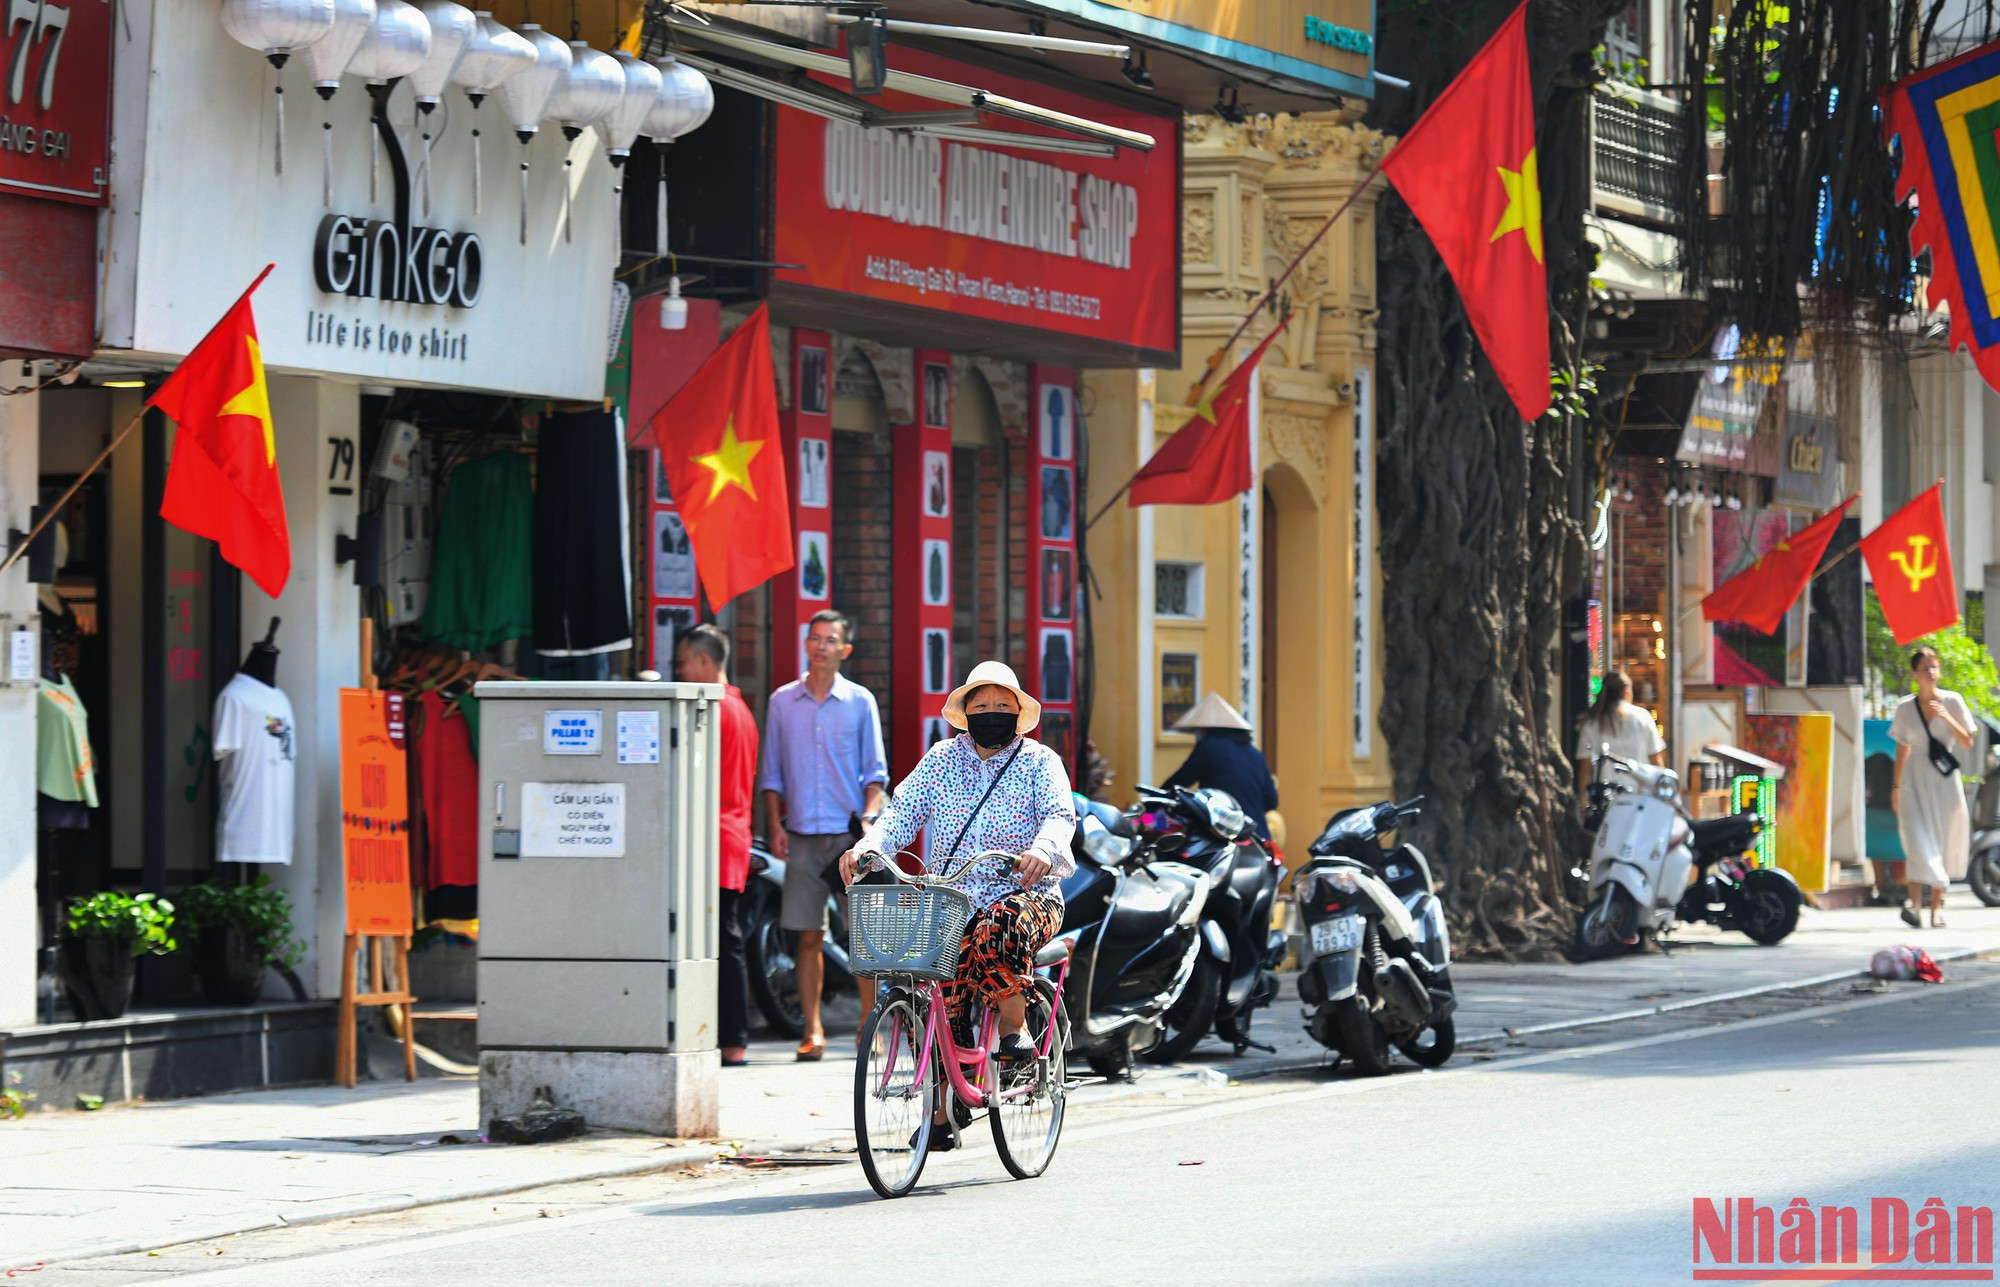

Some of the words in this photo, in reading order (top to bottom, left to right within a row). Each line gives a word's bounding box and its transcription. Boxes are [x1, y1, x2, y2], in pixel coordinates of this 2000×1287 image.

[6, 0, 70, 111] 77
[42, 128, 70, 158] GAI
[823, 118, 941, 229] OUTDOOR
[943, 142, 1078, 257] ADVENTURE
[1079, 172, 1138, 269] SHOP
[307, 311, 347, 347] life
[354, 318, 372, 349] is
[379, 323, 413, 354] too
[420, 327, 468, 361] shirt
[328, 437, 355, 481] 79
[584, 729, 595, 738] 12
